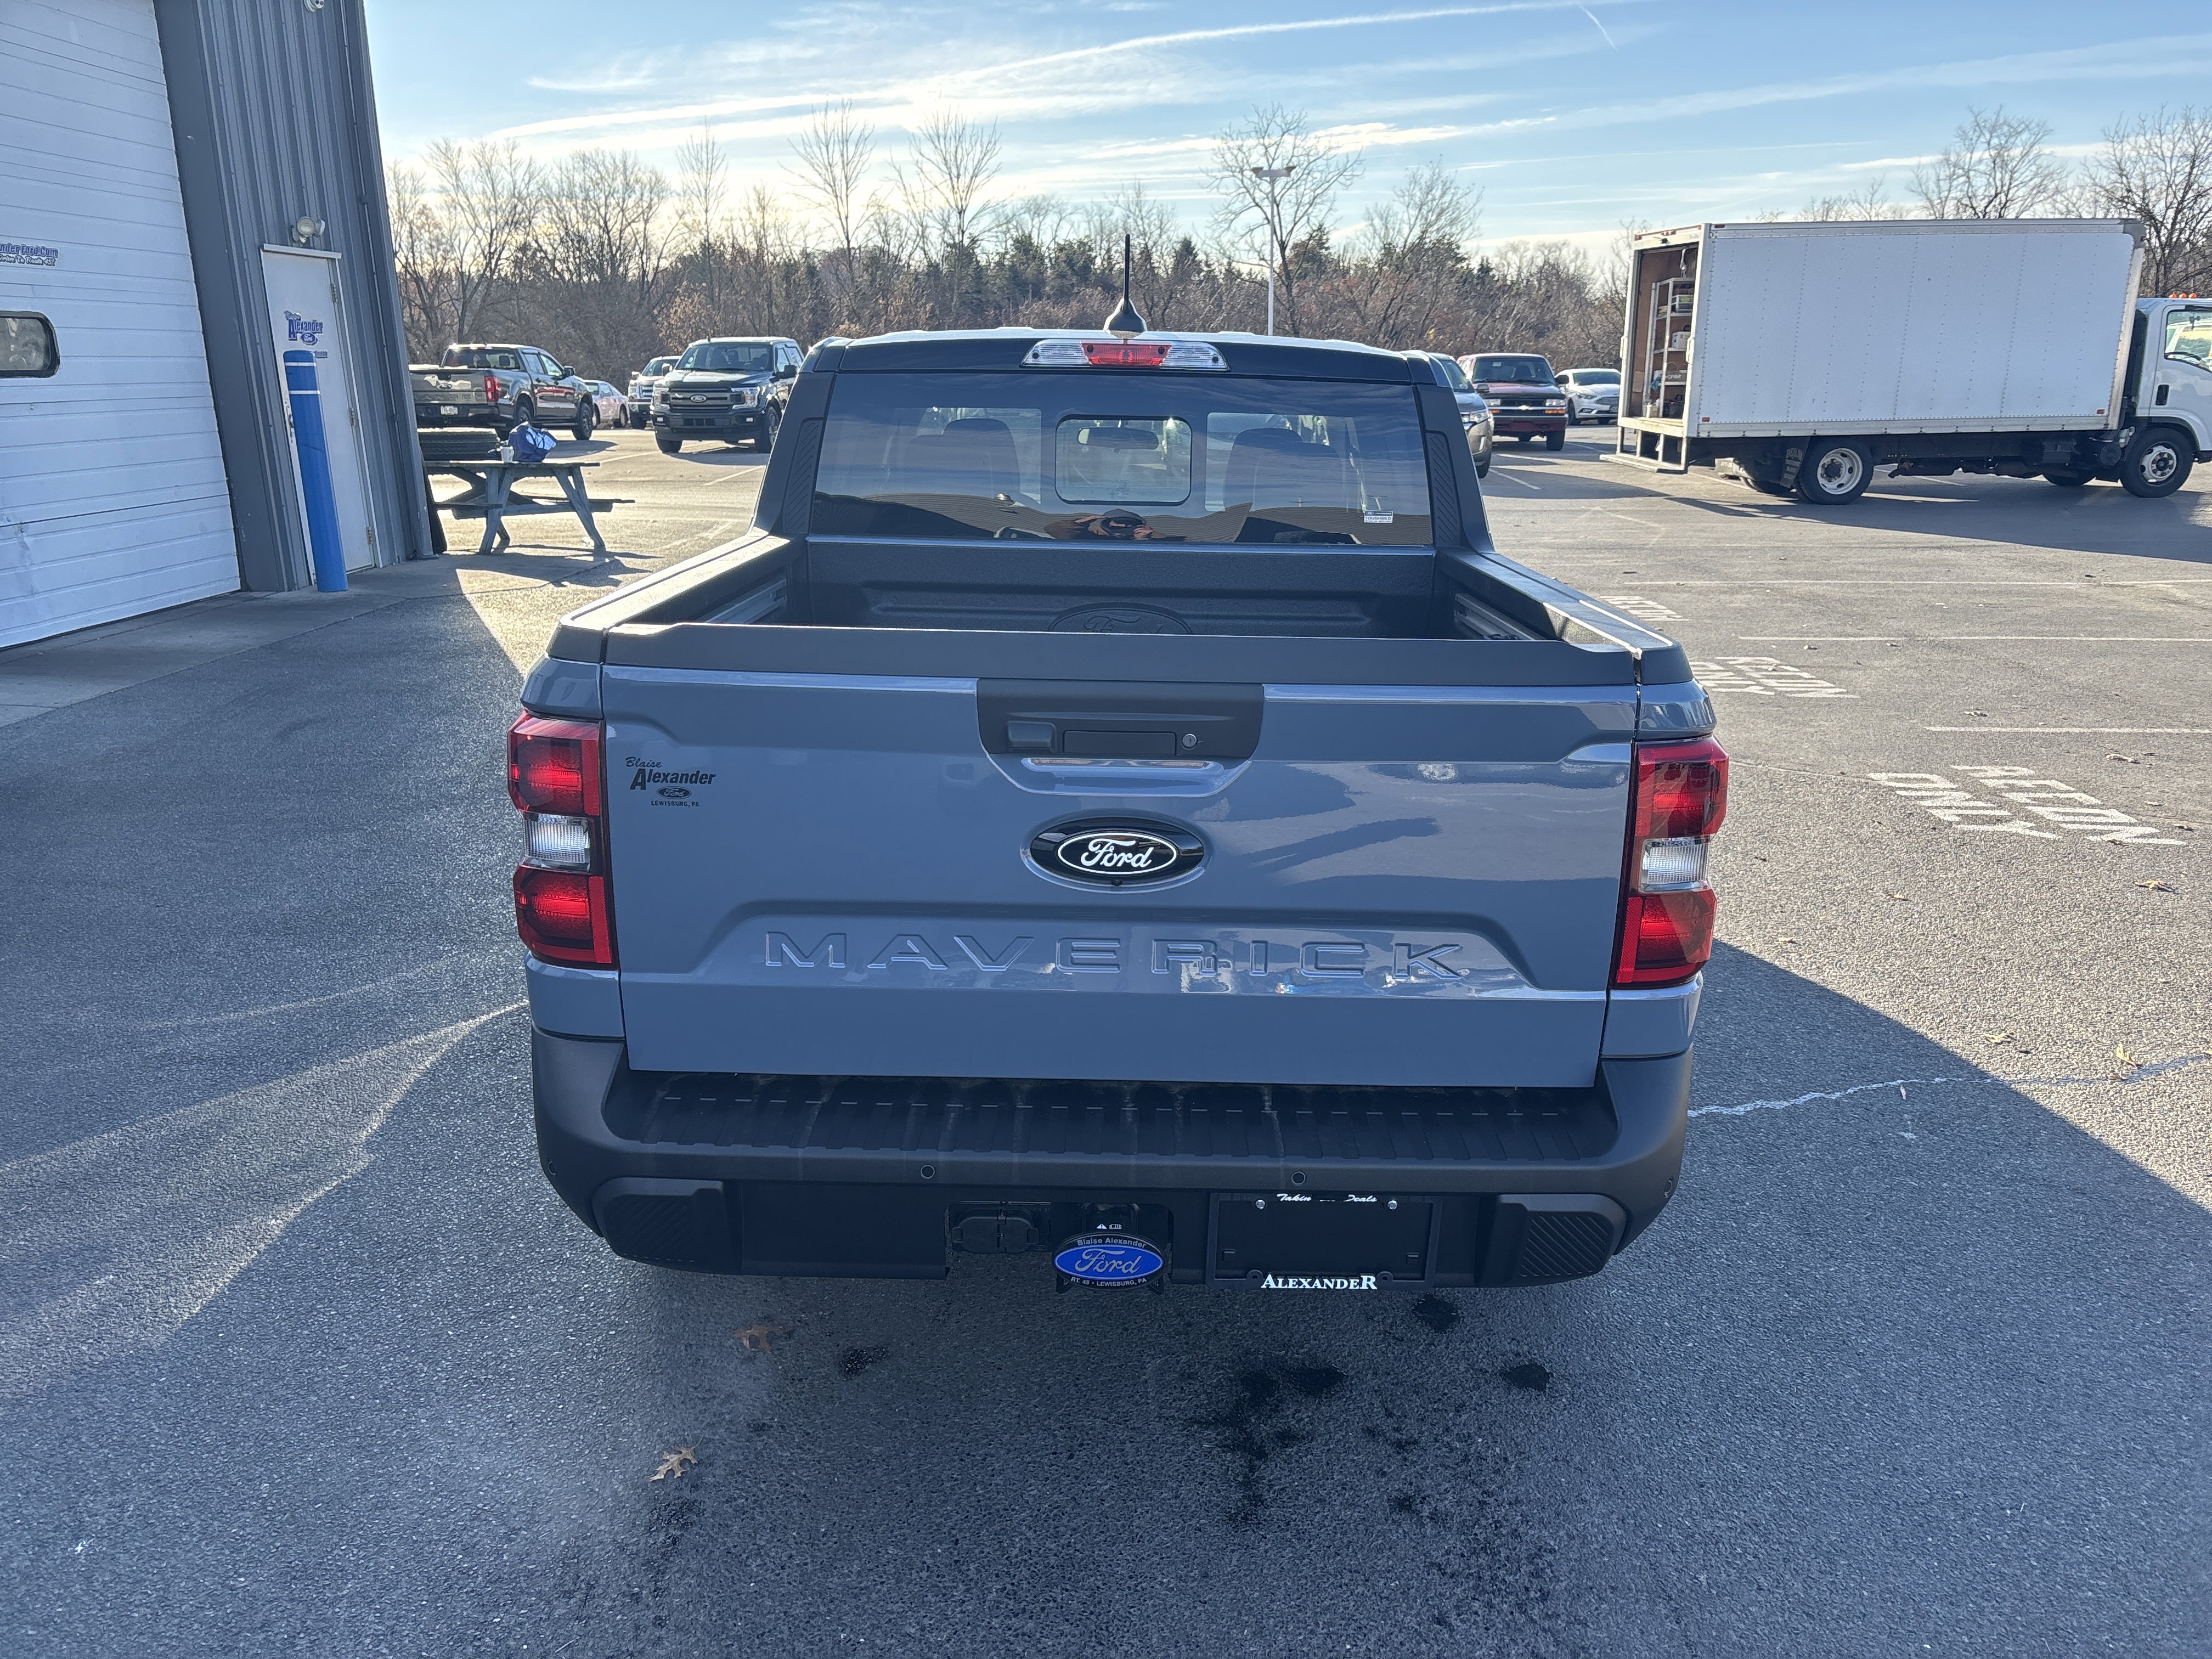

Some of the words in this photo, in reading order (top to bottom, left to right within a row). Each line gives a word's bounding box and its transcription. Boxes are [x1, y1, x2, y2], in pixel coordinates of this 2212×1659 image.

[0, 244, 19, 254] nder
[288, 319, 323, 340] Alexander
[1714, 657, 1859, 699] RECON
[625, 757, 662, 768] Blaise
[630, 769, 716, 790] Alexander
[664, 788, 685, 797] Ford
[1867, 772, 2062, 840] ONLY
[1949, 765, 2188, 845] RECON
[1080, 838, 1154, 867] Ford
[766, 932, 1464, 979] MAVERICK
[1276, 1193, 1312, 1201] Takin
[1077, 1238, 1103, 1246] Blaise
[1105, 1238, 1147, 1248] Alexander
[1075, 1248, 1142, 1273] Ford
[1261, 1274, 1378, 1290] ALEXANDER
